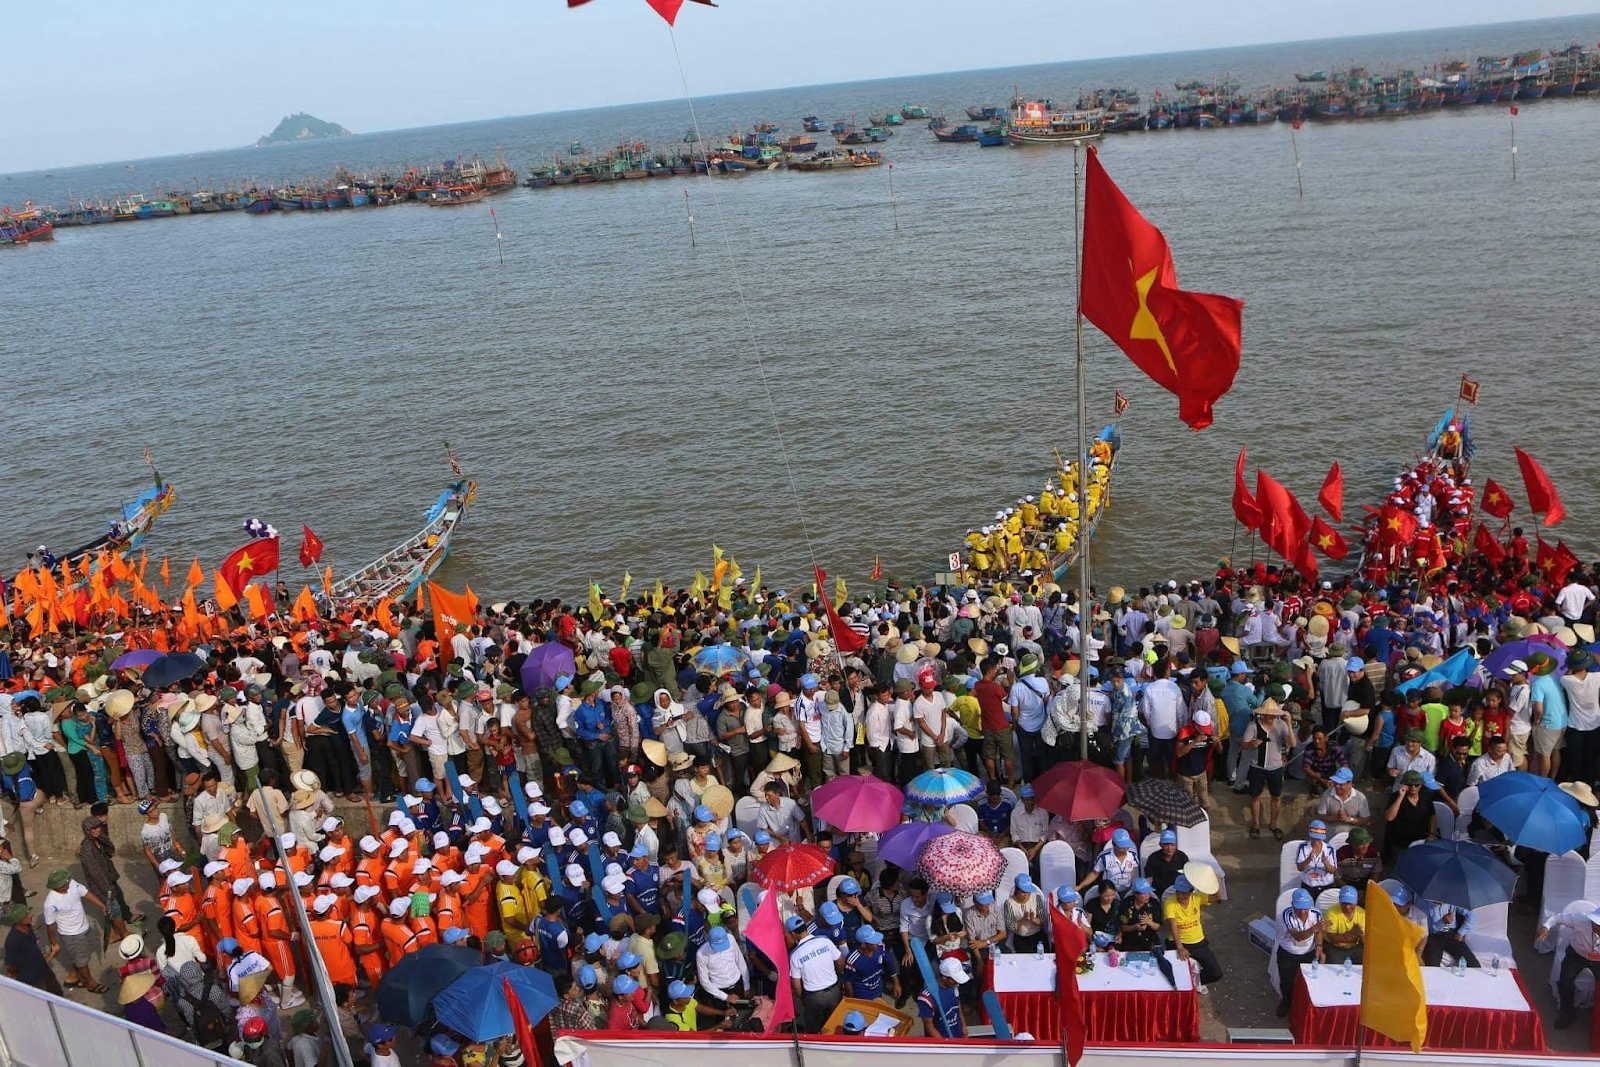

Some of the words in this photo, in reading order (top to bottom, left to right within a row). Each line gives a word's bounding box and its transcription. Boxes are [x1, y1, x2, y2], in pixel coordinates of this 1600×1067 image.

[951, 554, 958, 568] 3
[799, 954, 810, 964] BAN
[809, 950, 816, 959] TỔ
